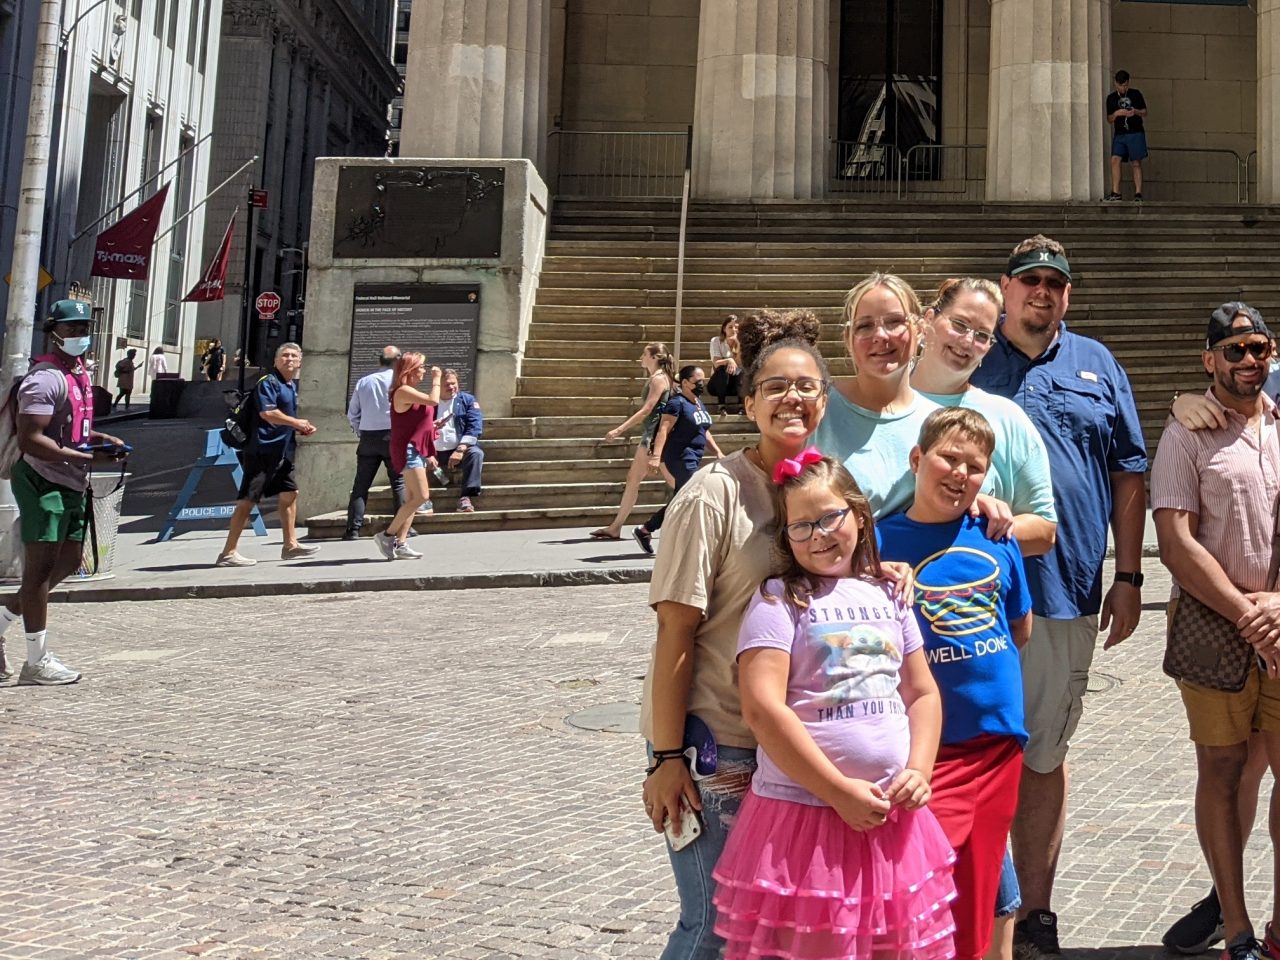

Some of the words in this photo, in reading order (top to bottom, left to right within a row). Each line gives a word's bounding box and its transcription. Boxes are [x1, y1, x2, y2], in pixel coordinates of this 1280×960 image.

[257, 299, 278, 308] STOP
[182, 508, 215, 516] POLICE
[925, 646, 972, 665] WELL
[975, 635, 1008, 657] DONE
[818, 705, 854, 723] THAN
[863, 701, 884, 716] YOU
